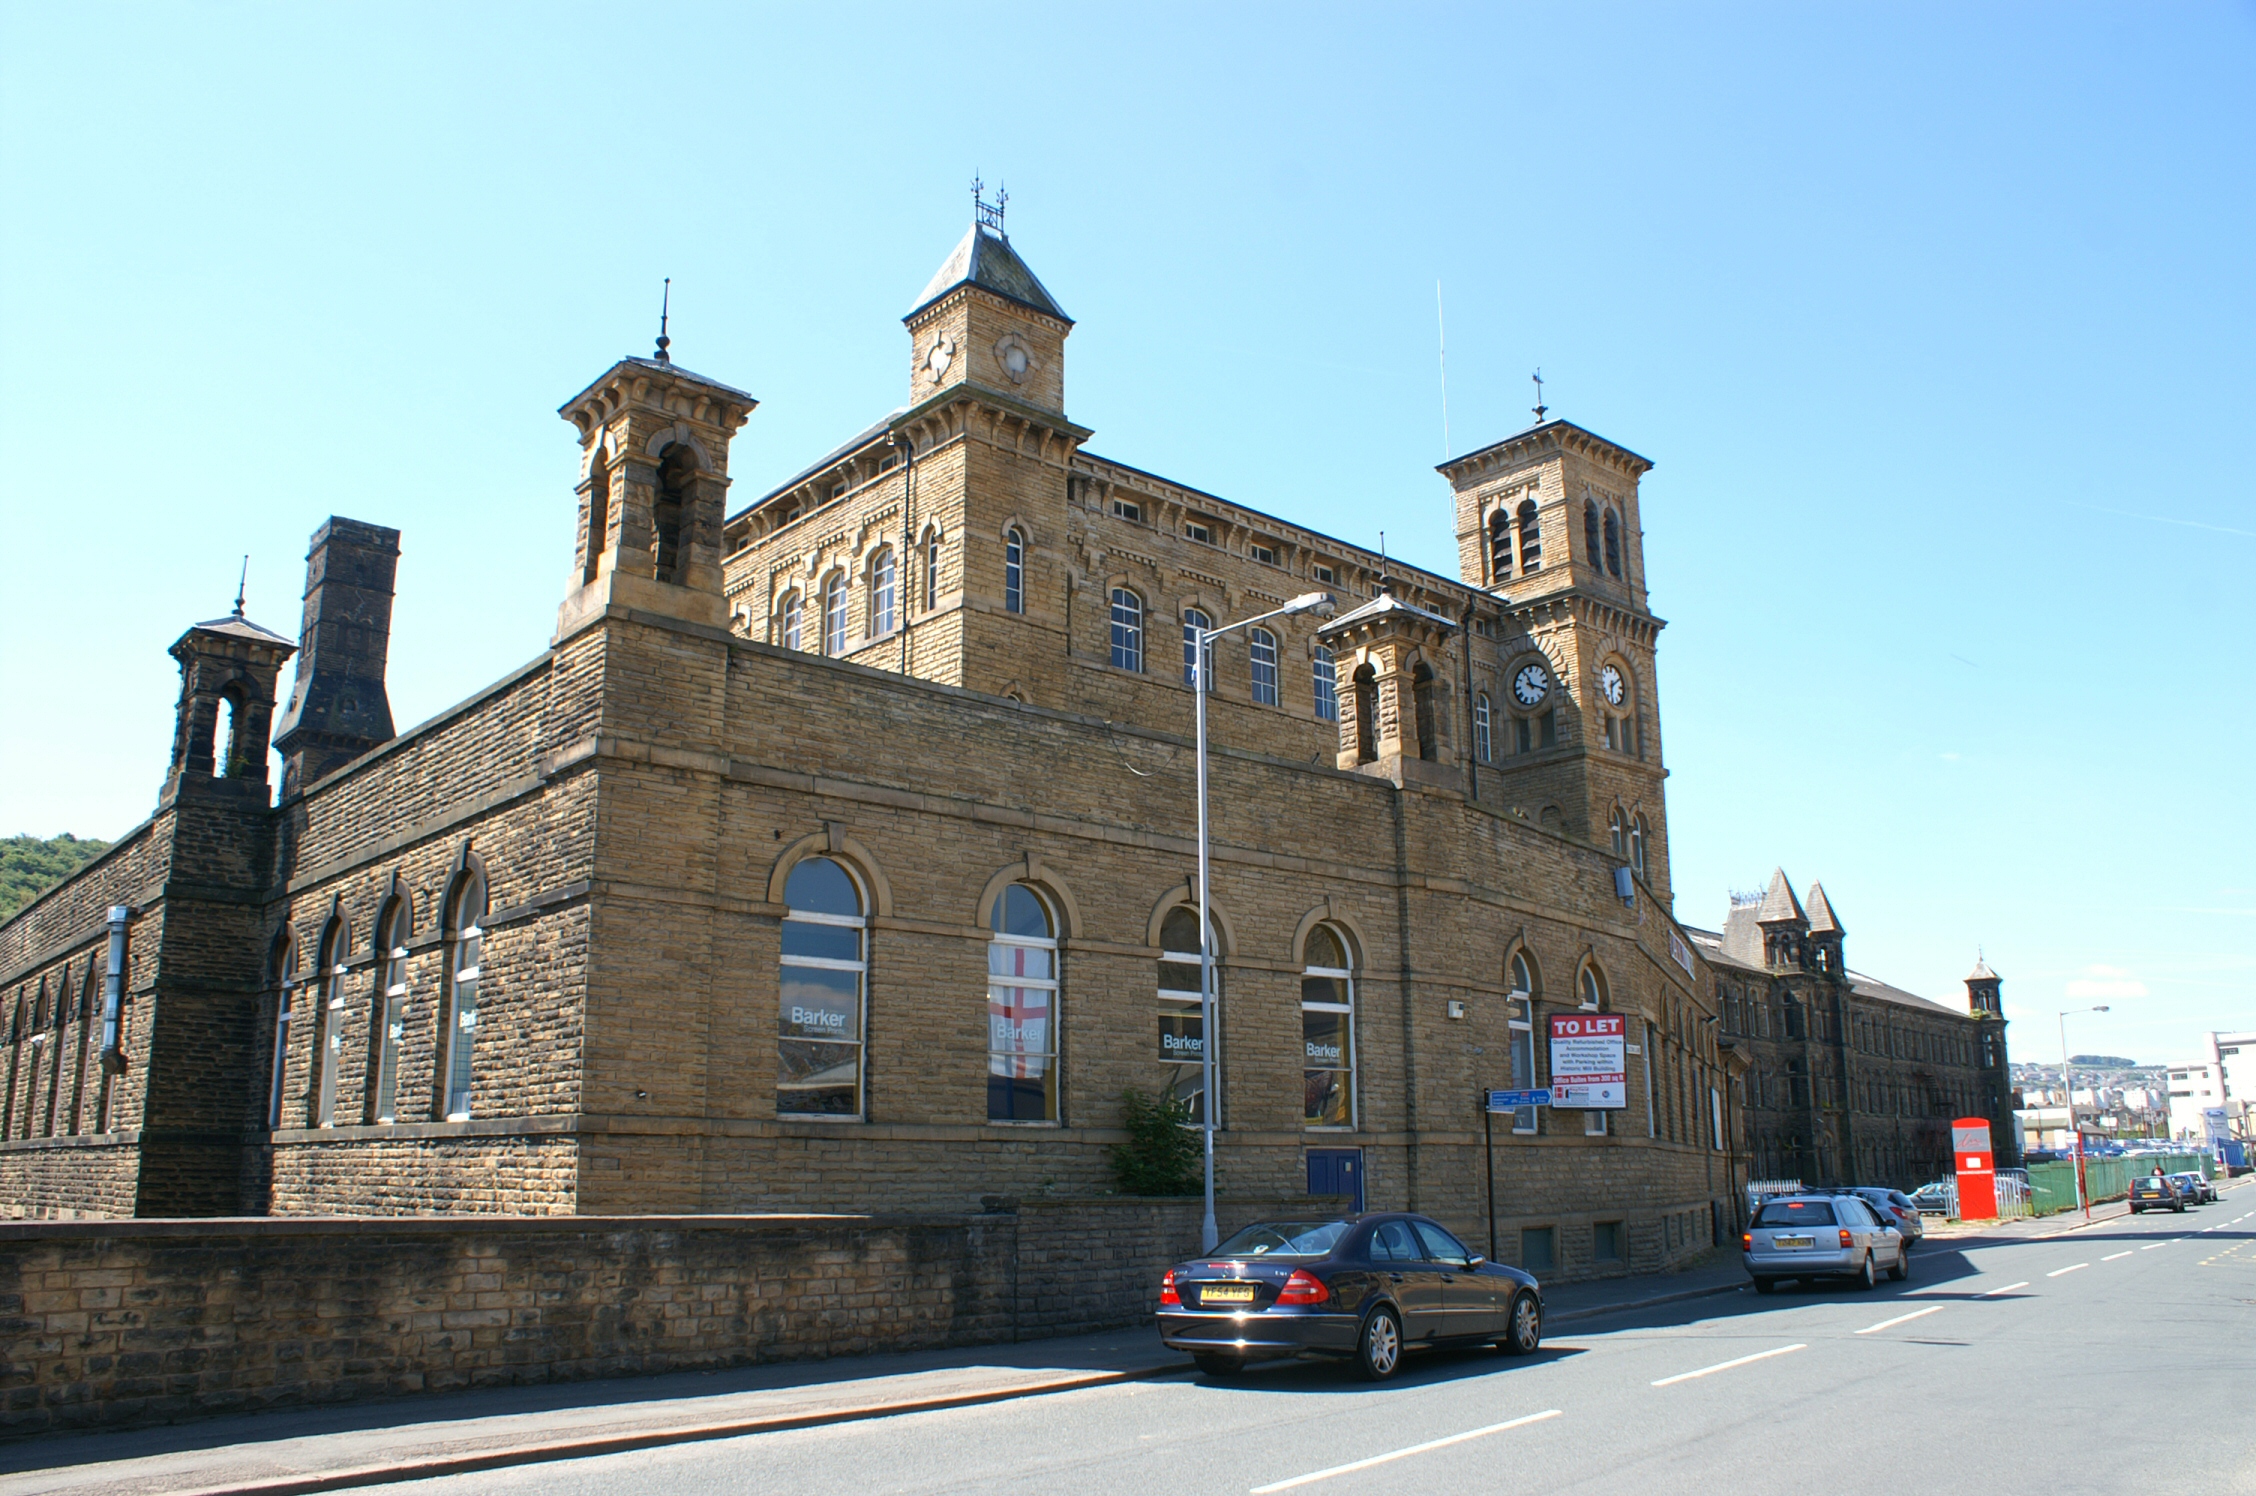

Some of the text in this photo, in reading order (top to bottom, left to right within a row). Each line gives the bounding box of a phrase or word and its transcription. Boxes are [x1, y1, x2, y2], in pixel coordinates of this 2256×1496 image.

[791, 1006, 847, 1027] Barker
[803, 1025, 826, 1033] Screen
[997, 1023, 1043, 1041] Barker
[1554, 1018, 1620, 1035] TO LET
[1163, 1033, 1204, 1051] Barker
[1306, 1042, 1341, 1058] Barker
[1587, 1075, 1600, 1083] from
